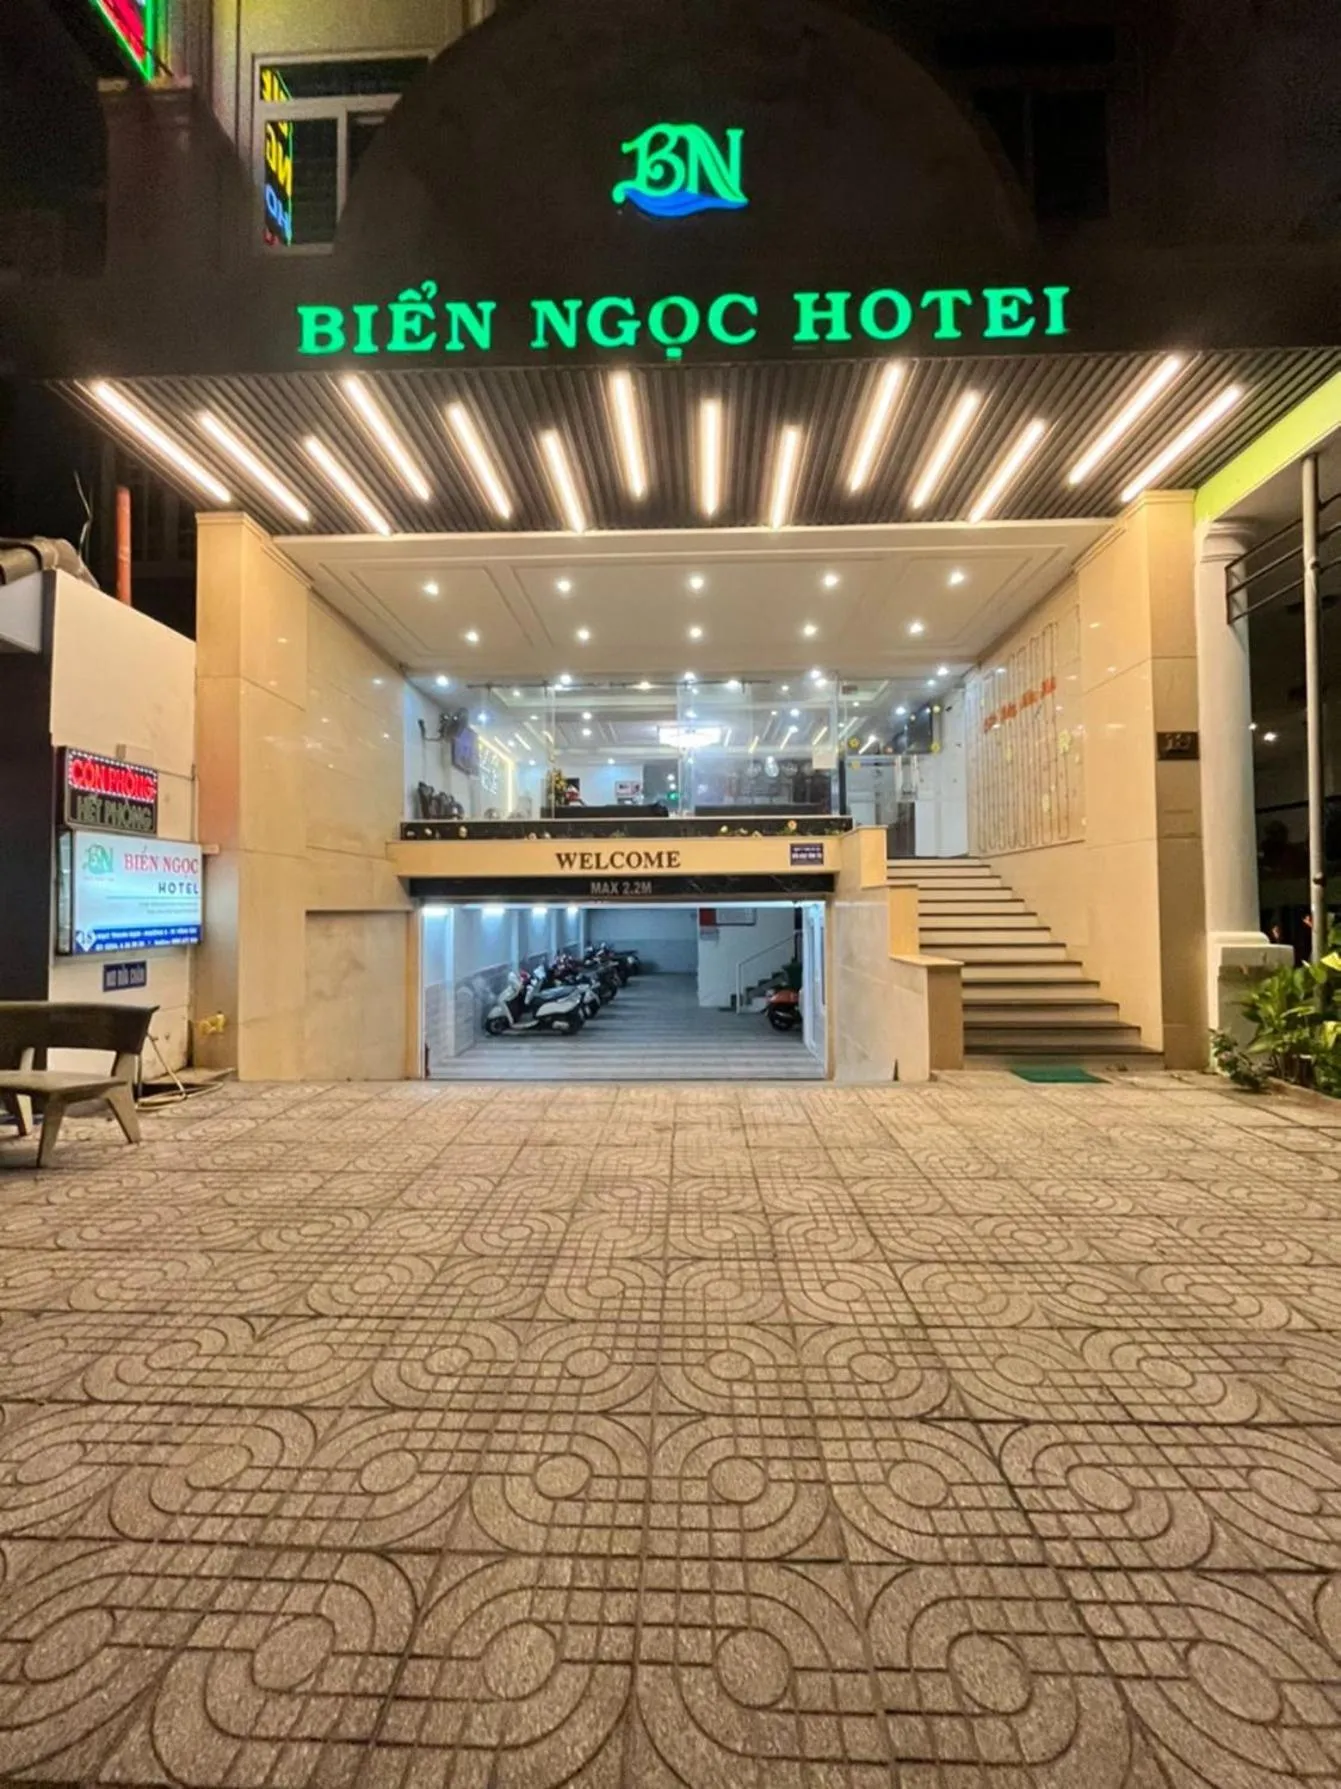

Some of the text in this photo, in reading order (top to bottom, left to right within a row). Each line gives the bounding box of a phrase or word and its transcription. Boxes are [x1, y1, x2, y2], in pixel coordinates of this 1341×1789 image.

[297, 281, 496, 355] BIỂN
[531, 294, 758, 359] NGỌC
[556, 851, 681, 870] WELCOME
[158, 881, 199, 894] HOTEL
[590, 881, 652, 894] MAX 2.2M
